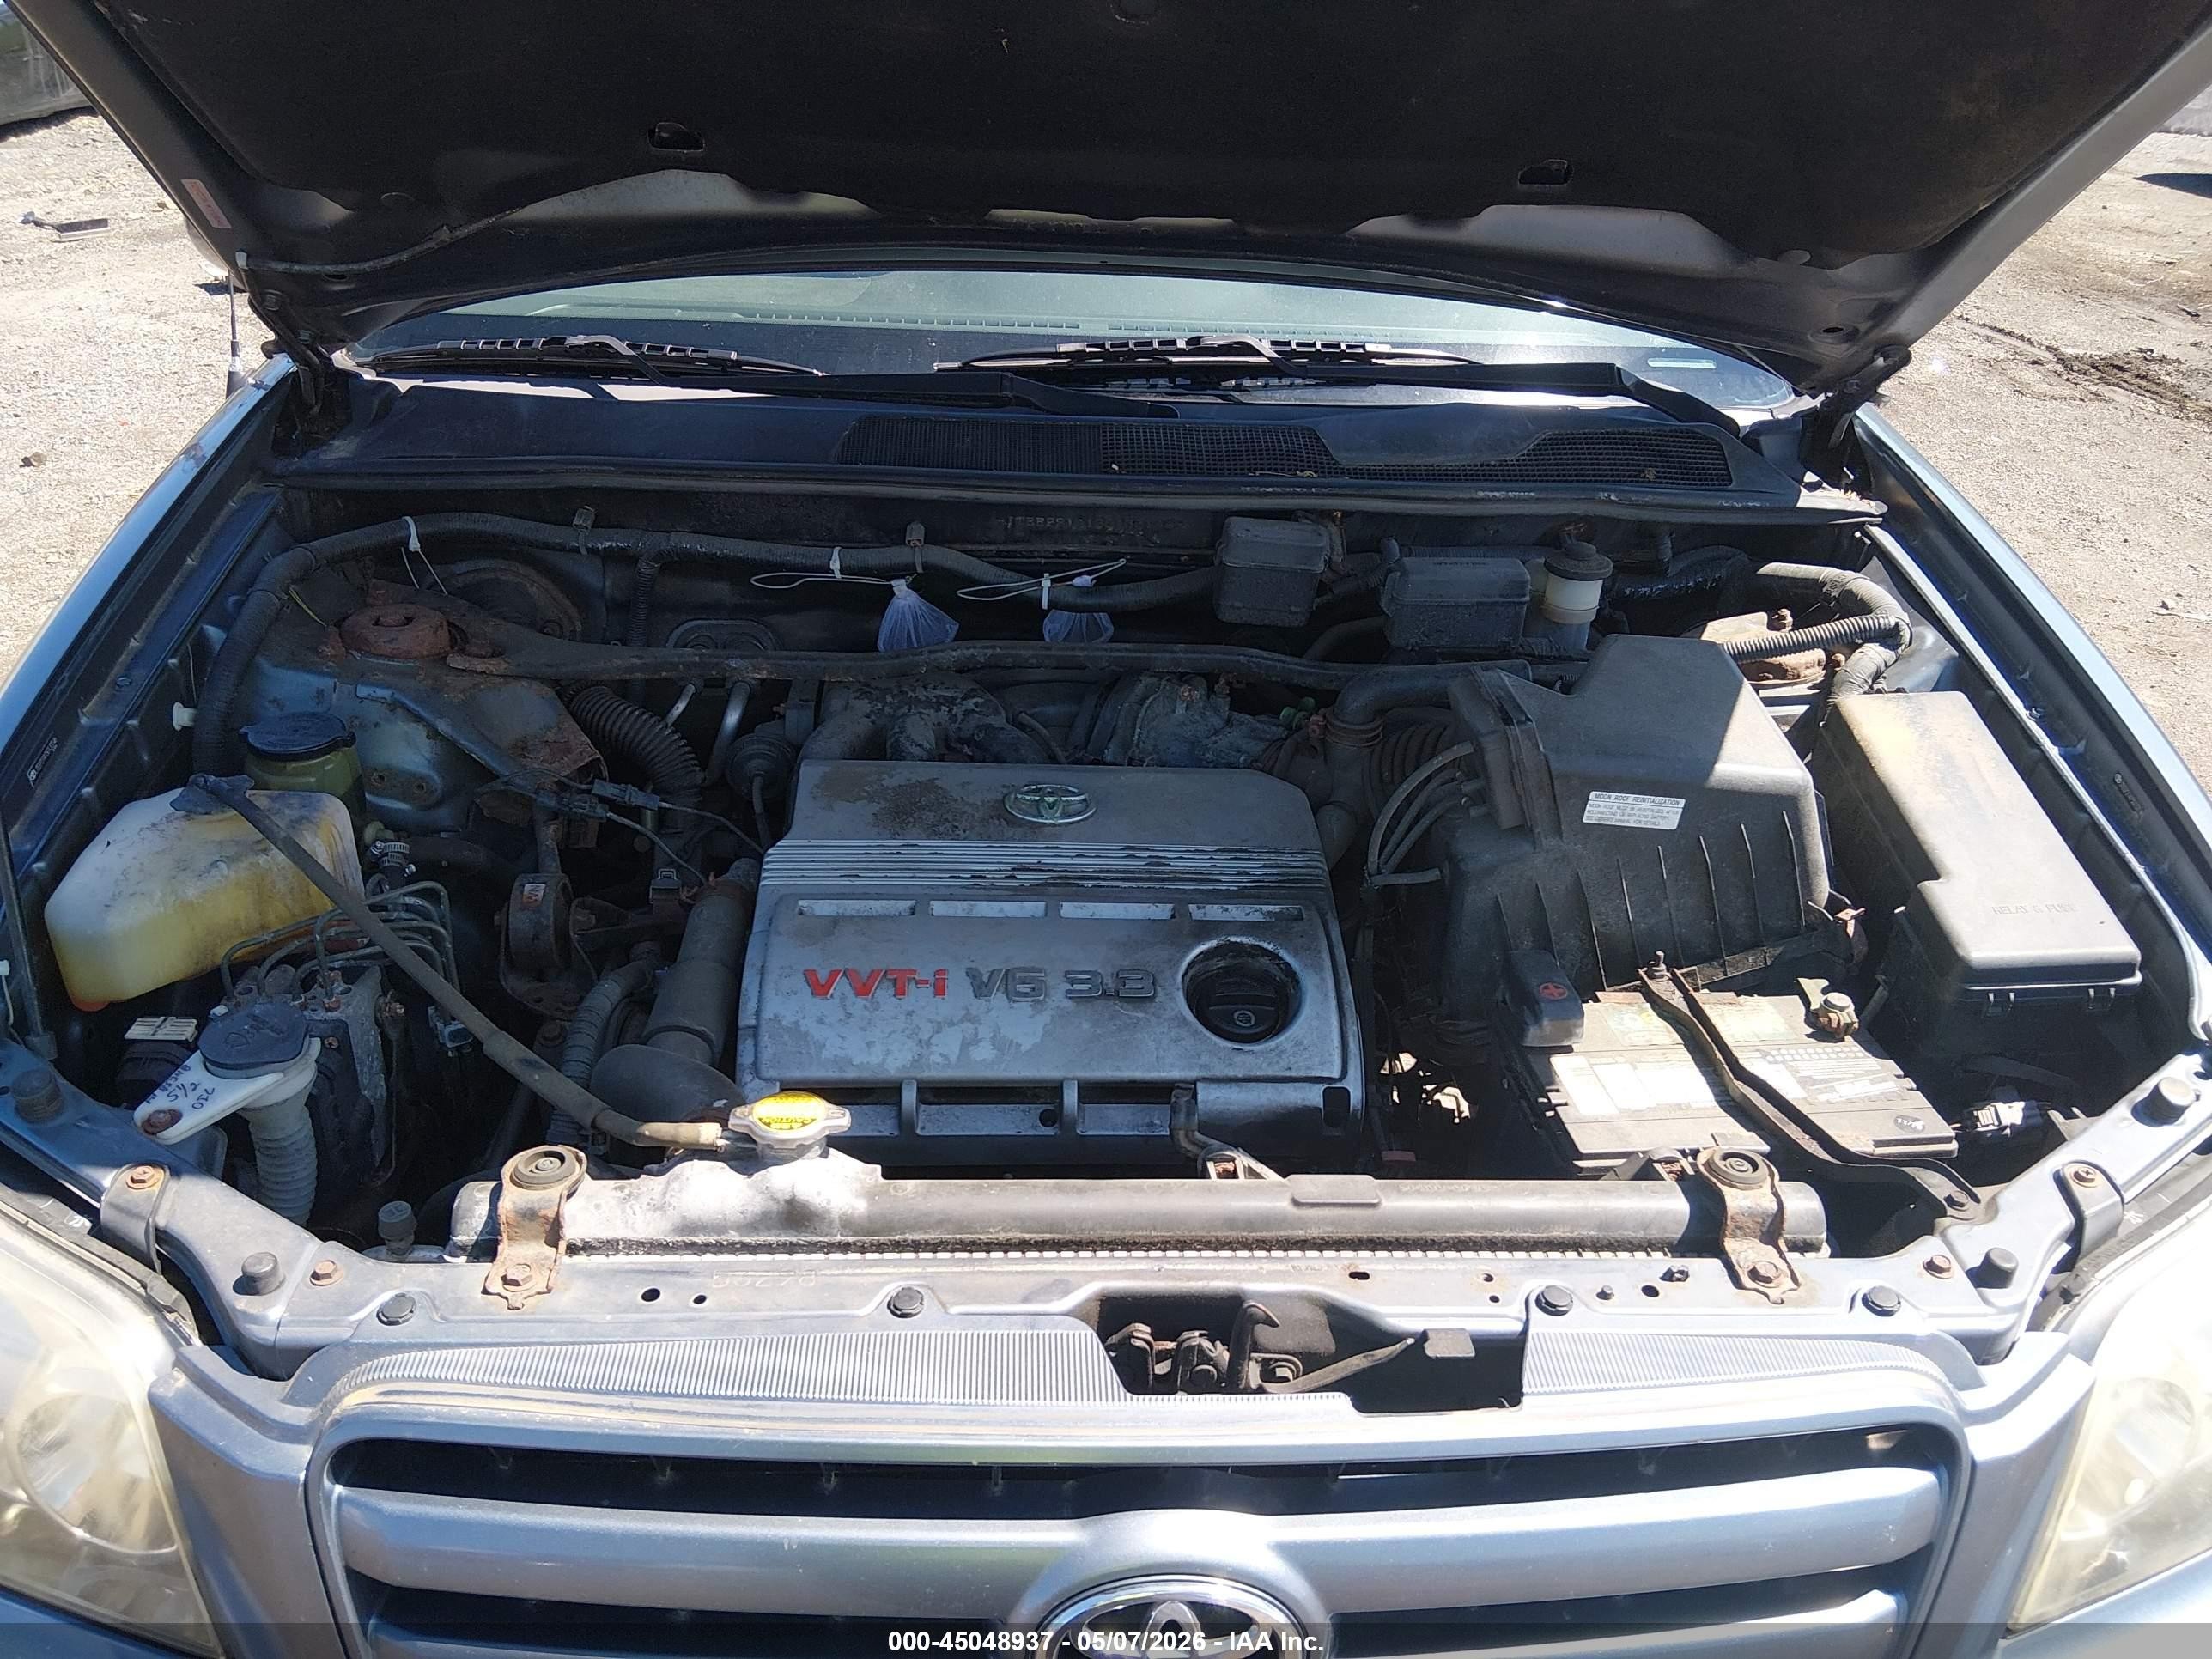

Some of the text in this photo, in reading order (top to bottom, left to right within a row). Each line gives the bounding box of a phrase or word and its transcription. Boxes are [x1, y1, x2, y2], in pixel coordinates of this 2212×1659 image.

[804, 967, 1157, 1002] VVT-i V6 3.3
[191, 1087, 215, 1109] OIL
